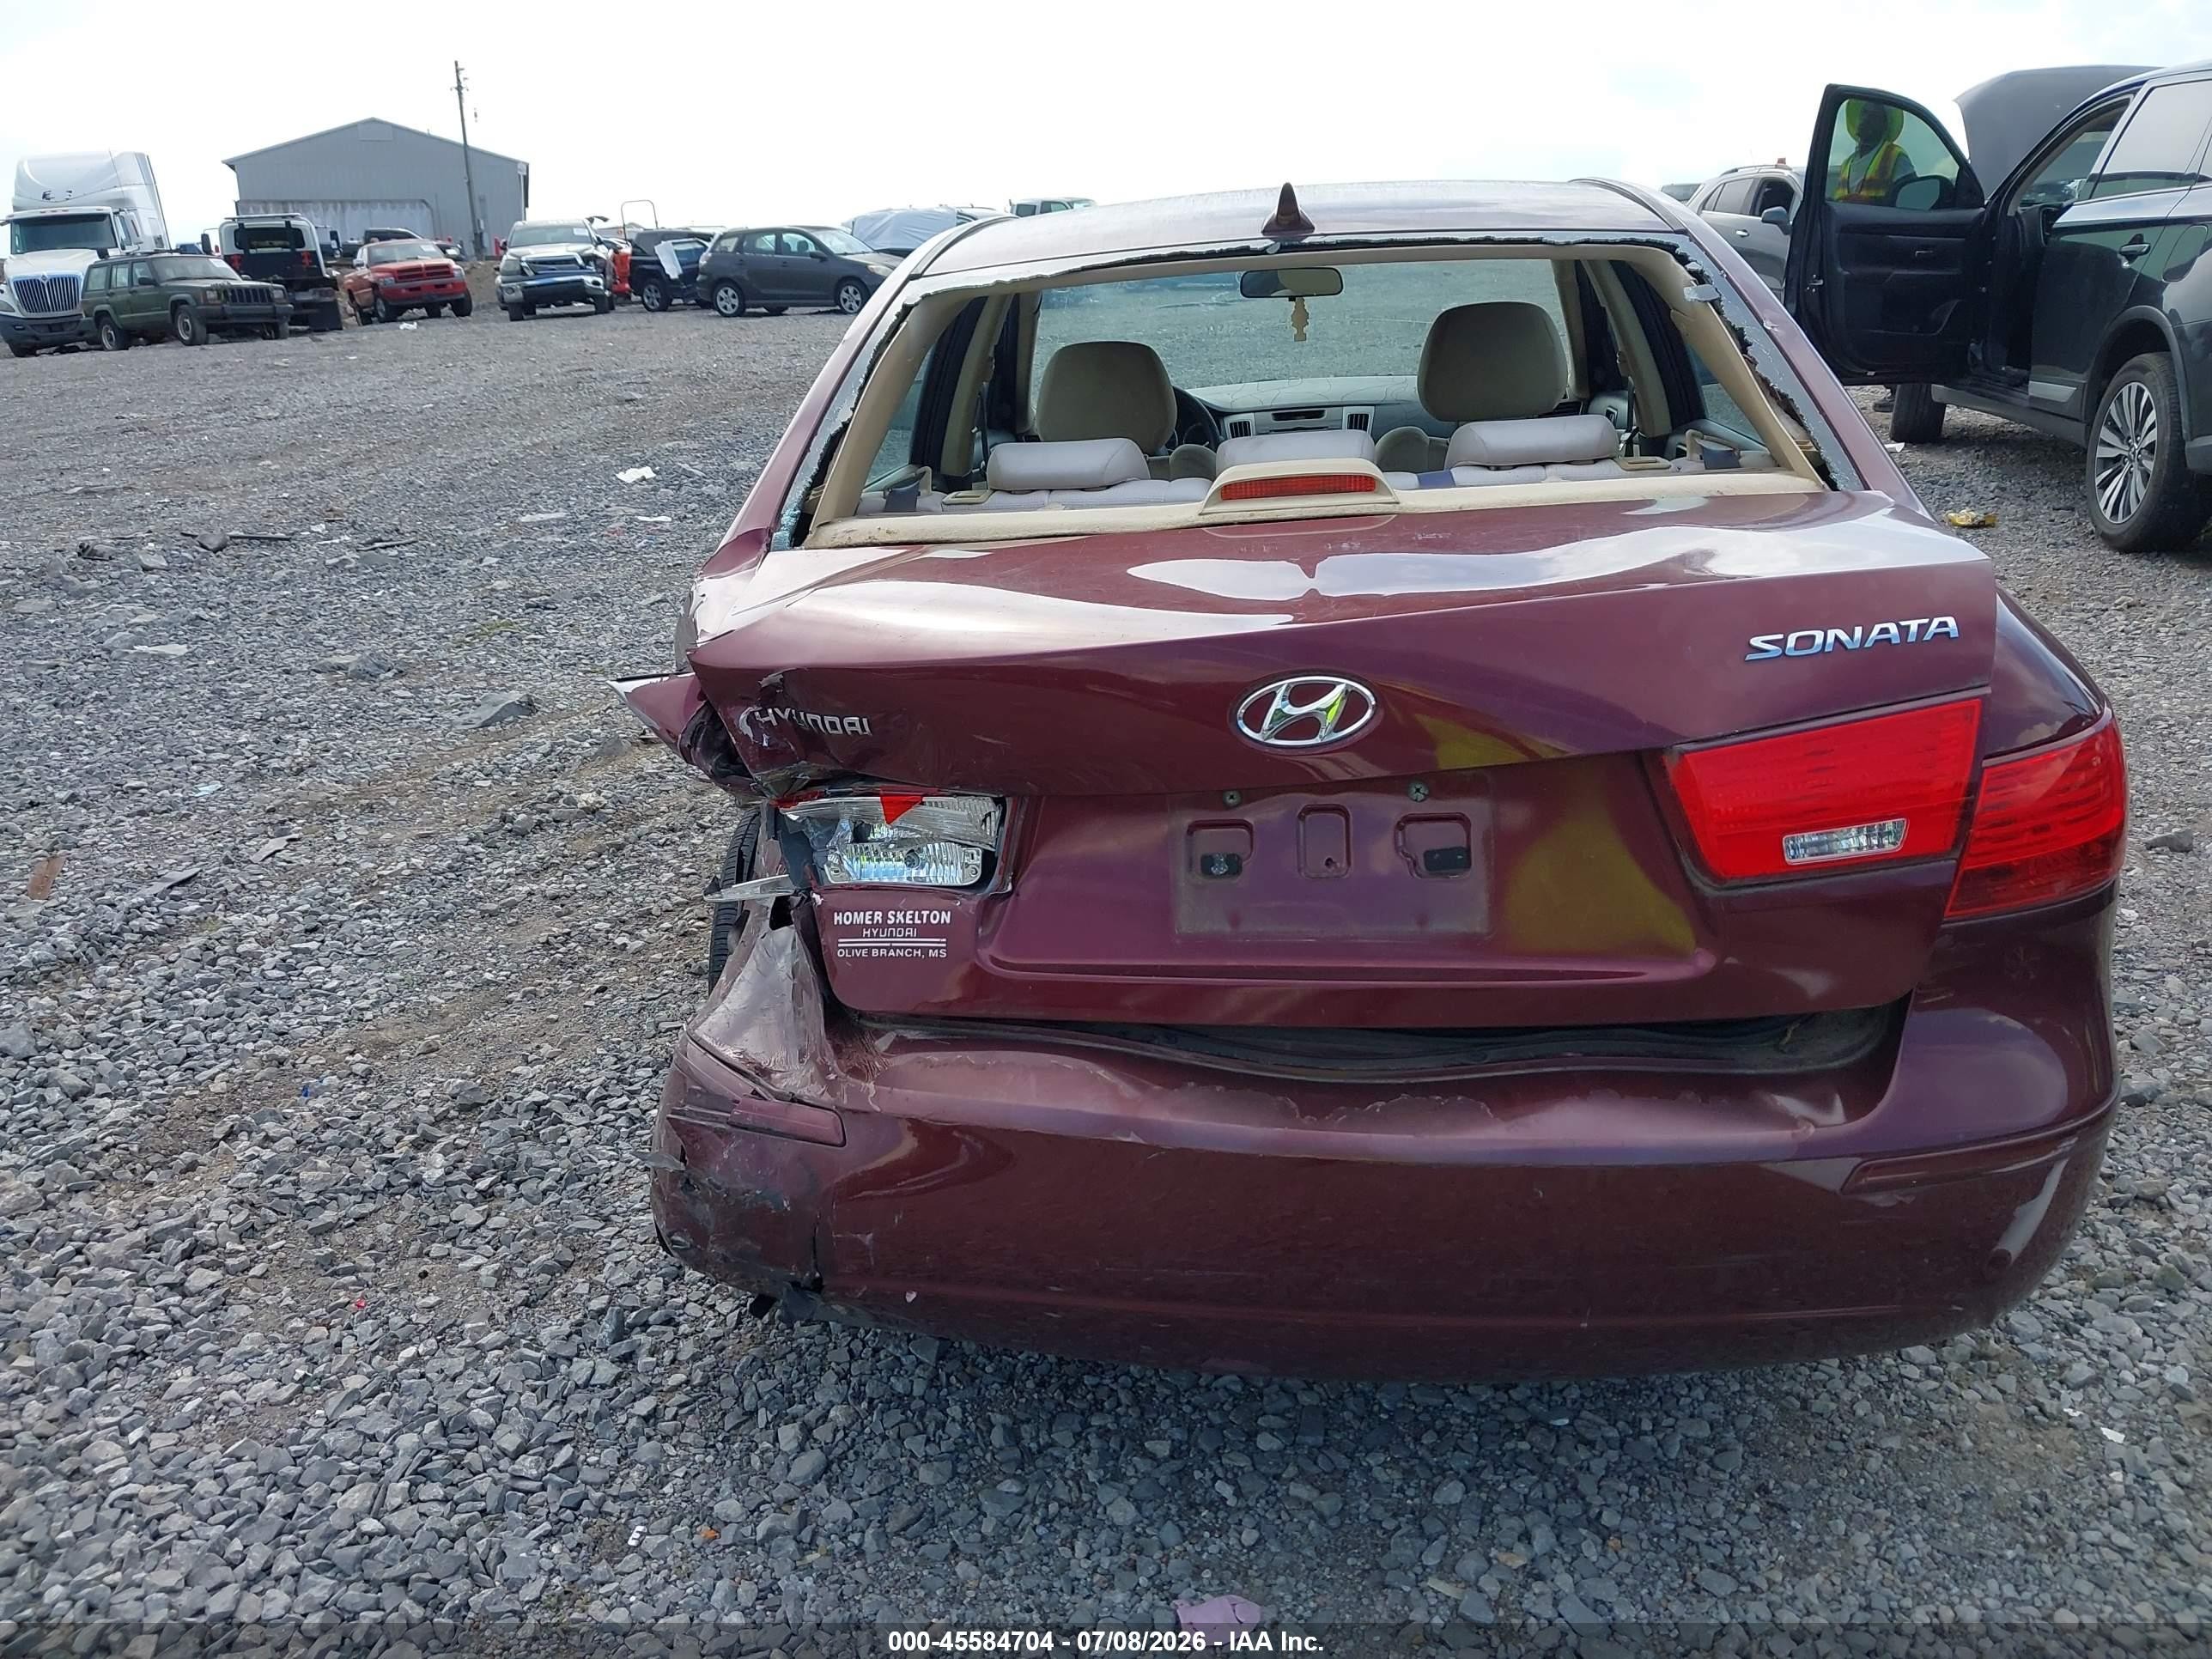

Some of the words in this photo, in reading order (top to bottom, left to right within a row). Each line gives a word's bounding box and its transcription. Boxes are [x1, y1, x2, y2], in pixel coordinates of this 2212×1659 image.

[1745, 616, 1960, 661] SONATA
[754, 707, 872, 737] HYUNDAI
[834, 910, 883, 925] HOMER
[887, 910, 951, 925] SKELTON
[863, 927, 917, 938] HYUNDAI
[837, 948, 868, 957] OLIVE
[872, 948, 925, 958] BRANCH,
[928, 948, 947, 957] MS
